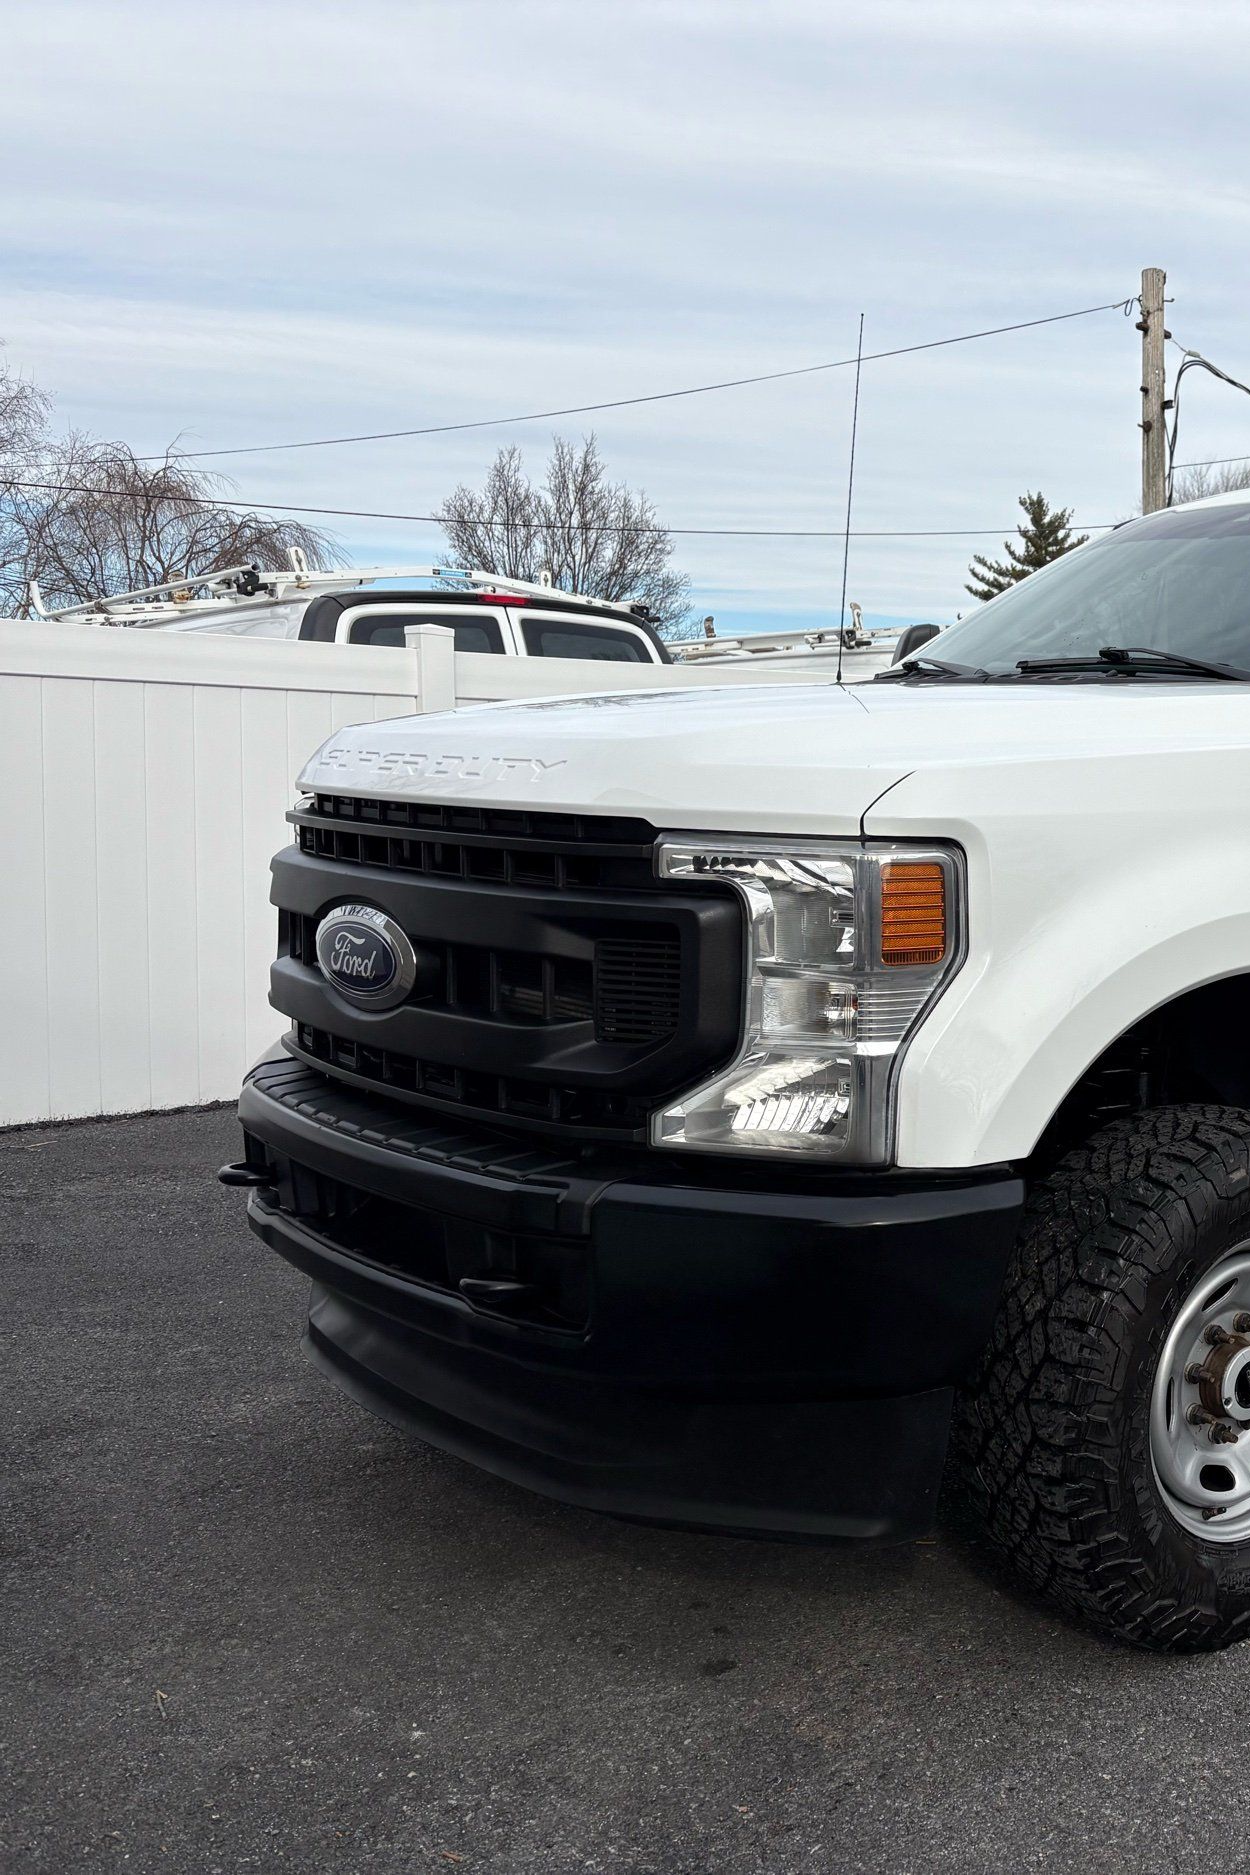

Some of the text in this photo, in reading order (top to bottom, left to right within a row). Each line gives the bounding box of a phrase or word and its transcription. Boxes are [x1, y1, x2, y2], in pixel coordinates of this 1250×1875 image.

[319, 749, 568, 782] SUPER DUTY
[331, 931, 377, 979] Ford
